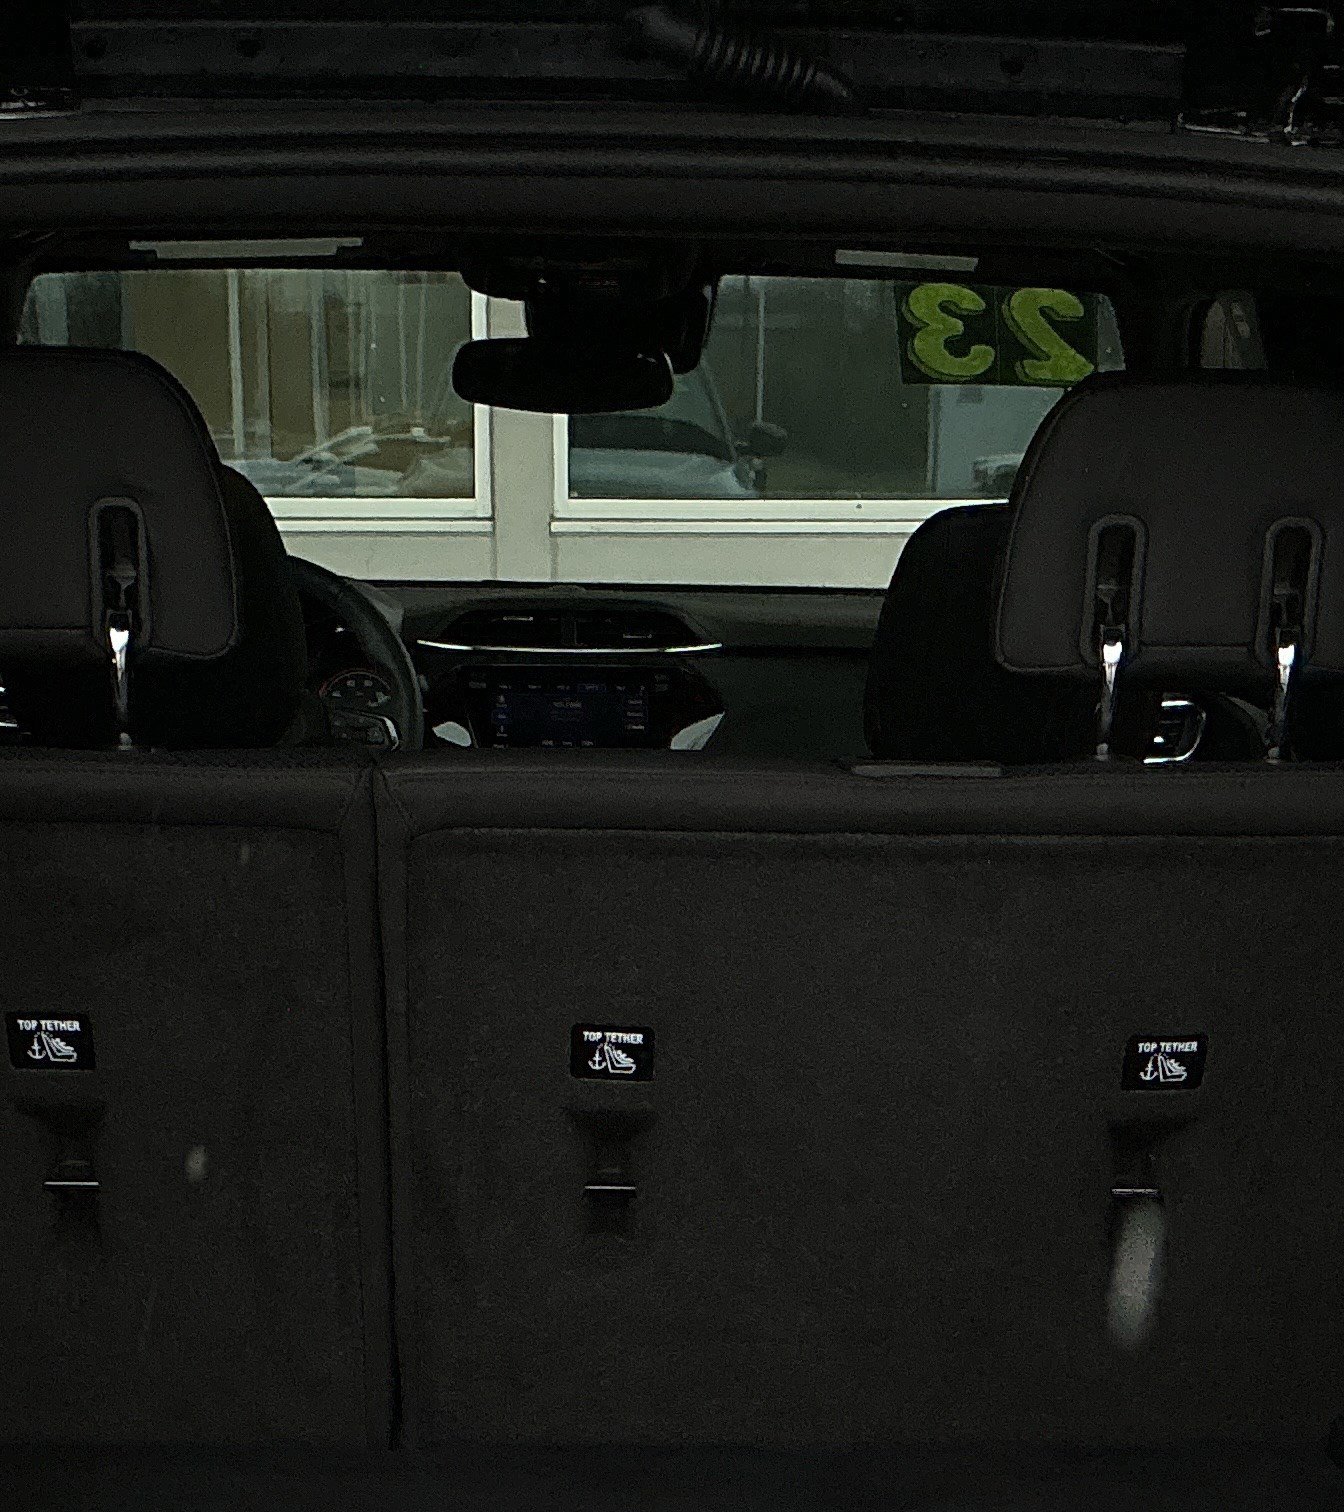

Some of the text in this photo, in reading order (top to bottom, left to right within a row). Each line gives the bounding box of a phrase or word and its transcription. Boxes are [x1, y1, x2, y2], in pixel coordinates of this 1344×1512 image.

[17, 1019, 81, 1031] TOP TETHER
[583, 1031, 643, 1044] TOP TETHER
[1138, 1041, 1197, 1053] TOP TETHER
